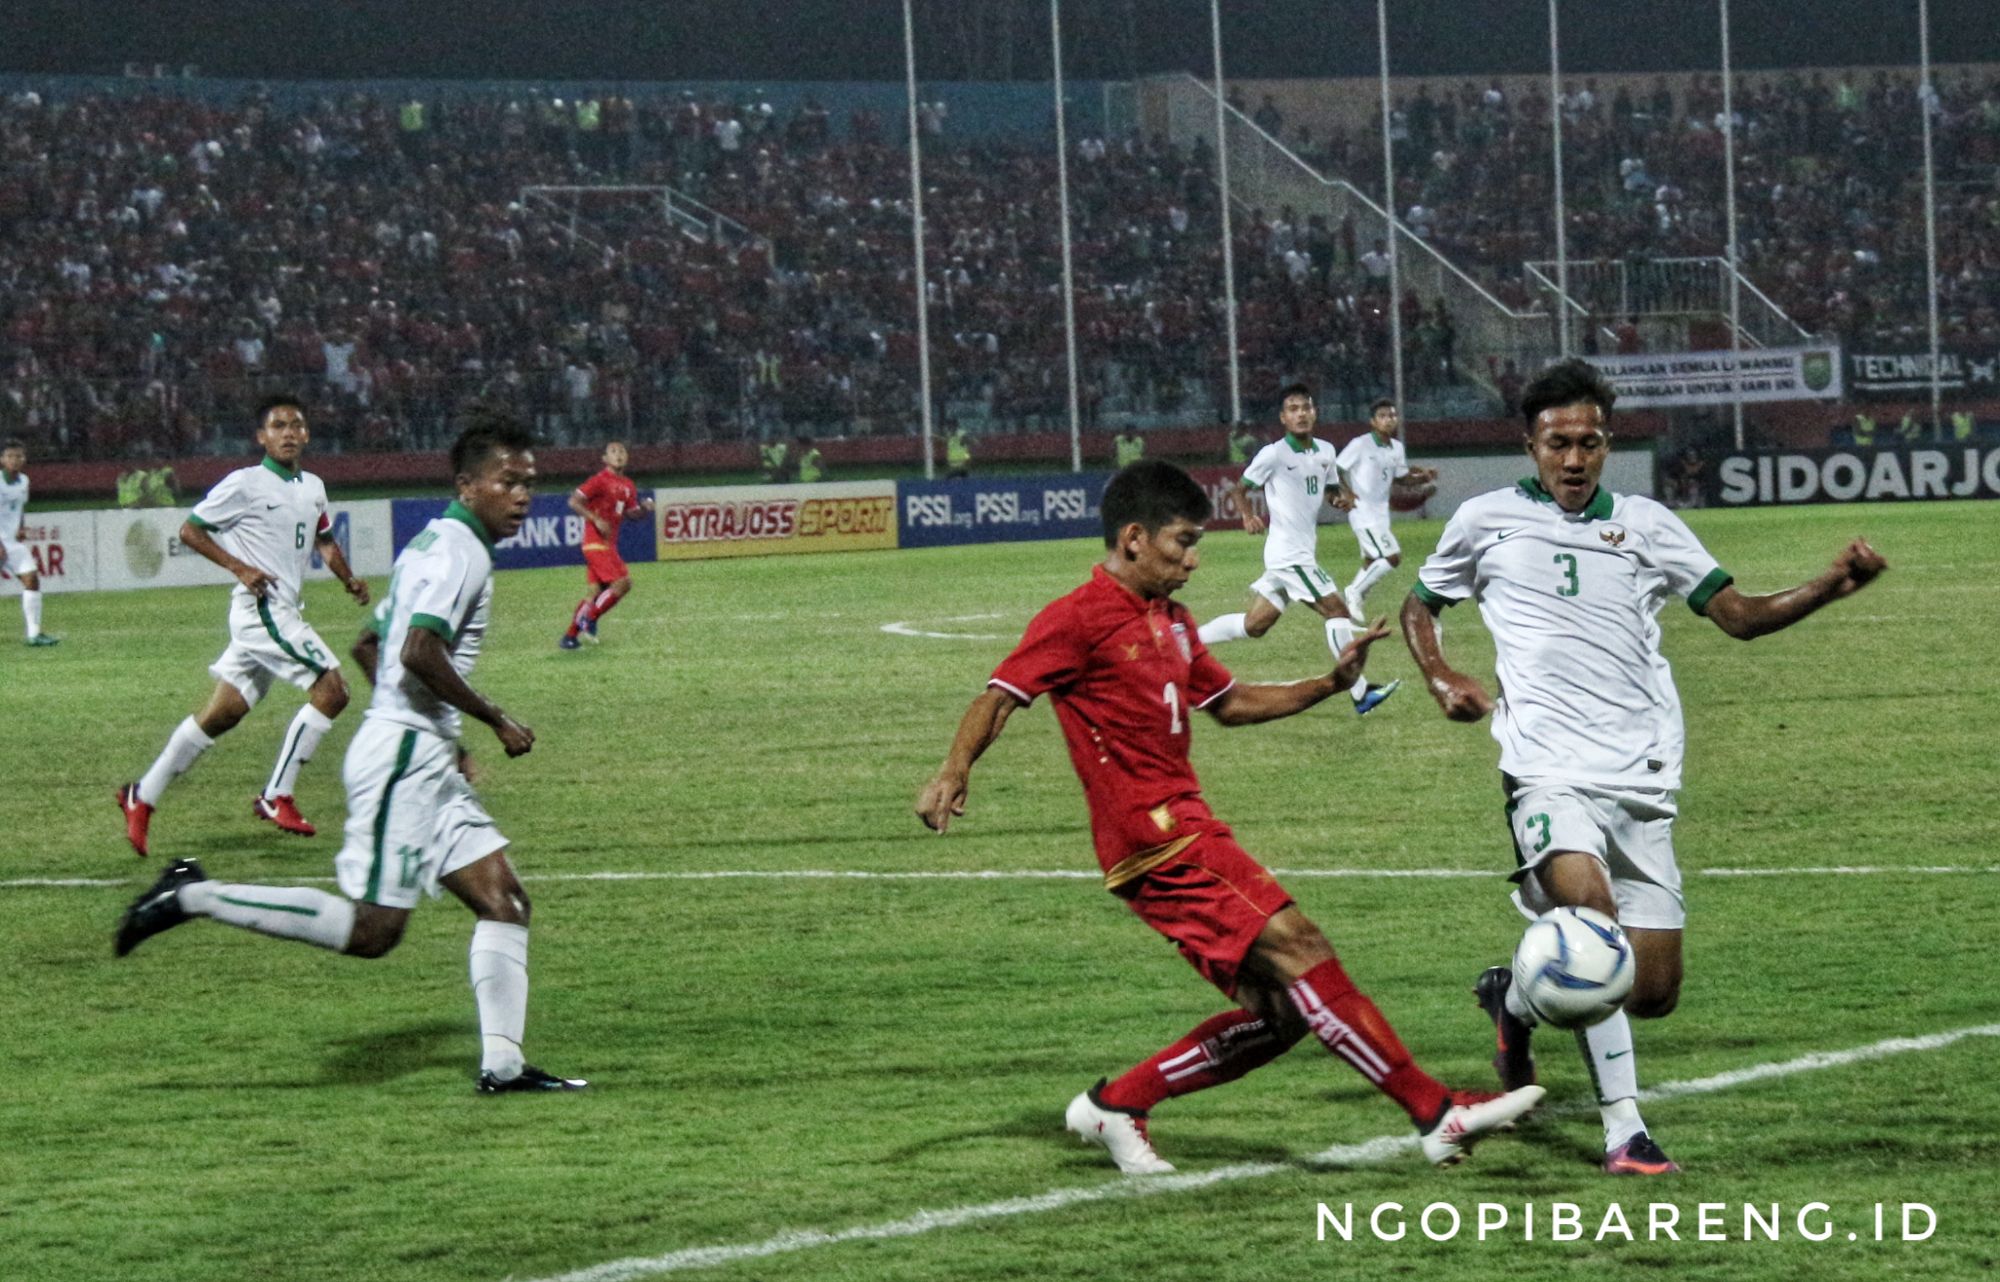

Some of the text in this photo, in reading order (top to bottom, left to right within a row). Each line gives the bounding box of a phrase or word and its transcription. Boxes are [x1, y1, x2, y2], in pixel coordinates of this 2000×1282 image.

[1305, 475, 1319, 495] 18
[295, 522, 306, 549] 6
[662, 496, 893, 542] EXTRAJOSS SPORT
[1554, 552, 1580, 597] 3
[1526, 812, 1552, 852] 3
